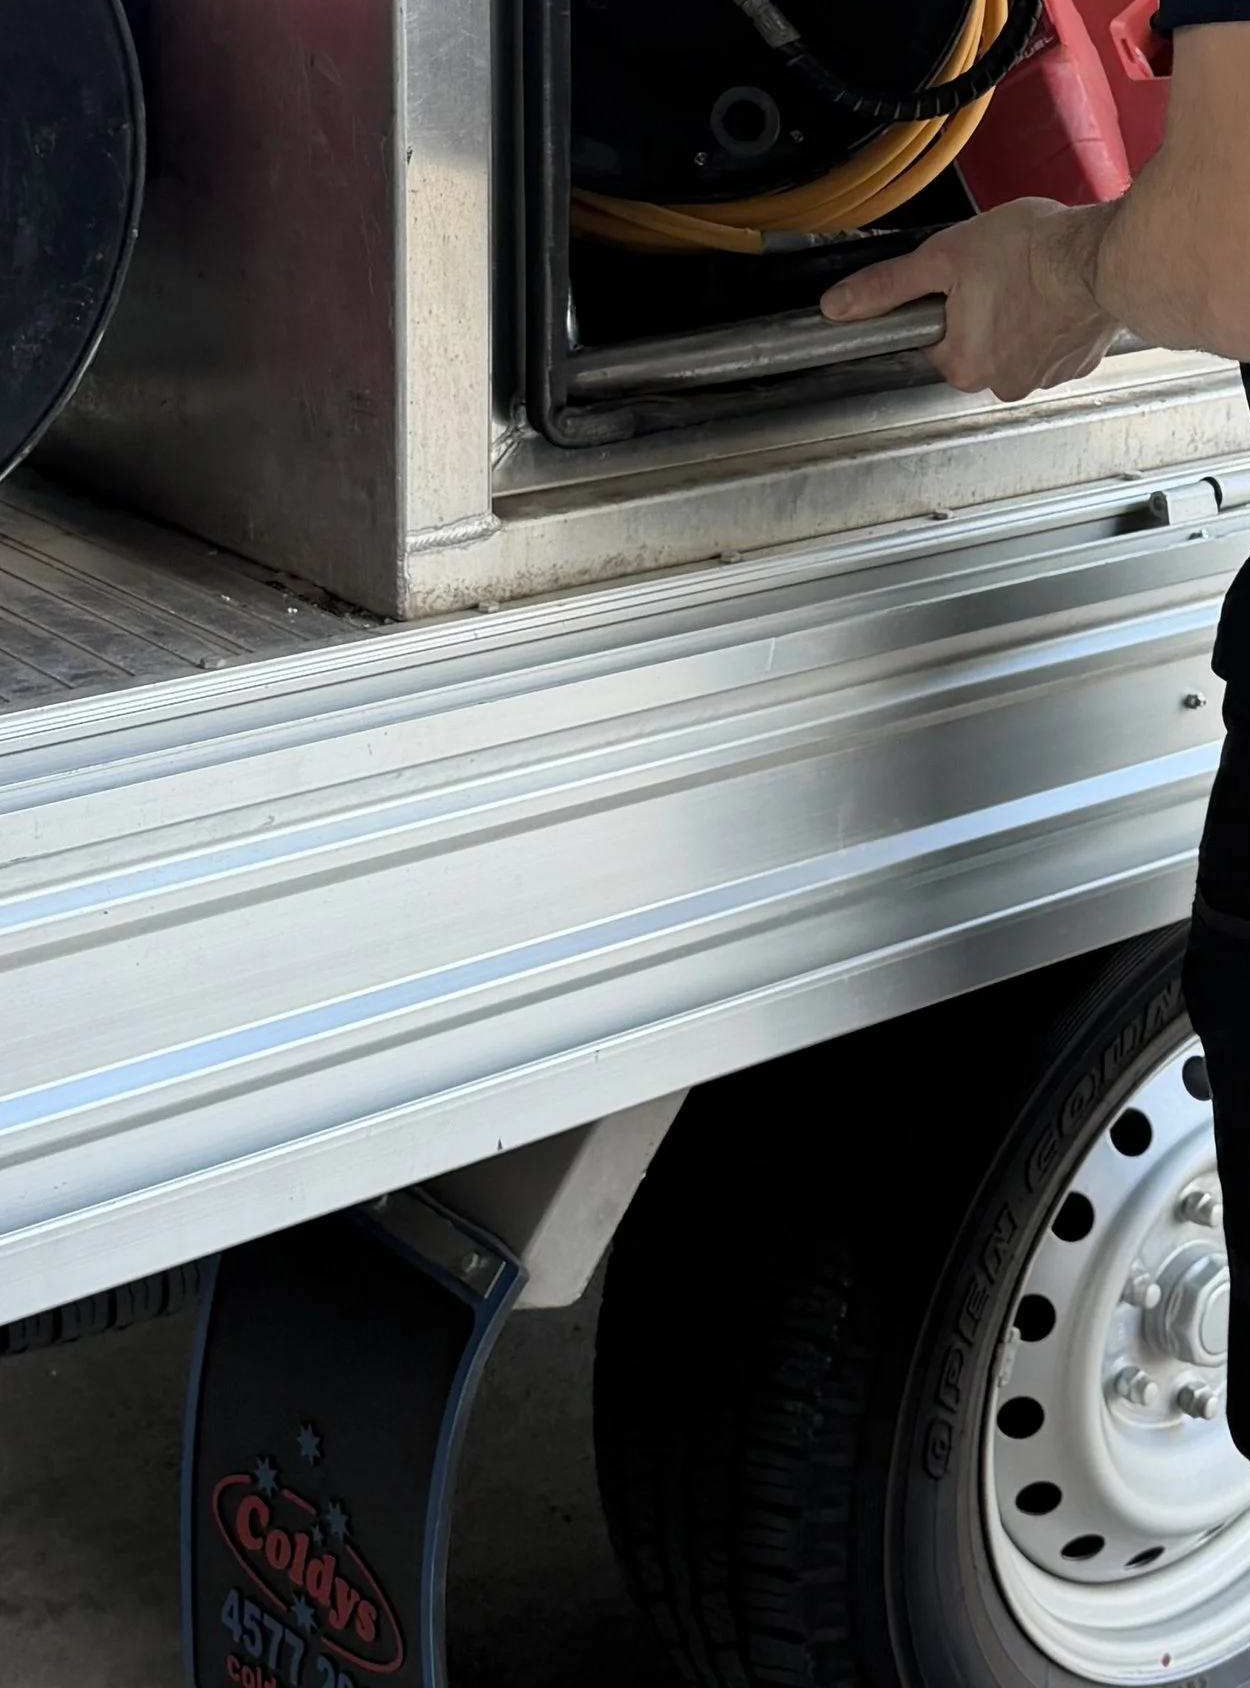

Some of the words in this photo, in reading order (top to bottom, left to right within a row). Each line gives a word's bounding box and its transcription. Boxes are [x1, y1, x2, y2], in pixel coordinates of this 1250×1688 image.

[922, 1201, 1018, 1480] OPEN
[221, 1588, 306, 1687] 4577
[235, 1495, 378, 1643] Coldys
